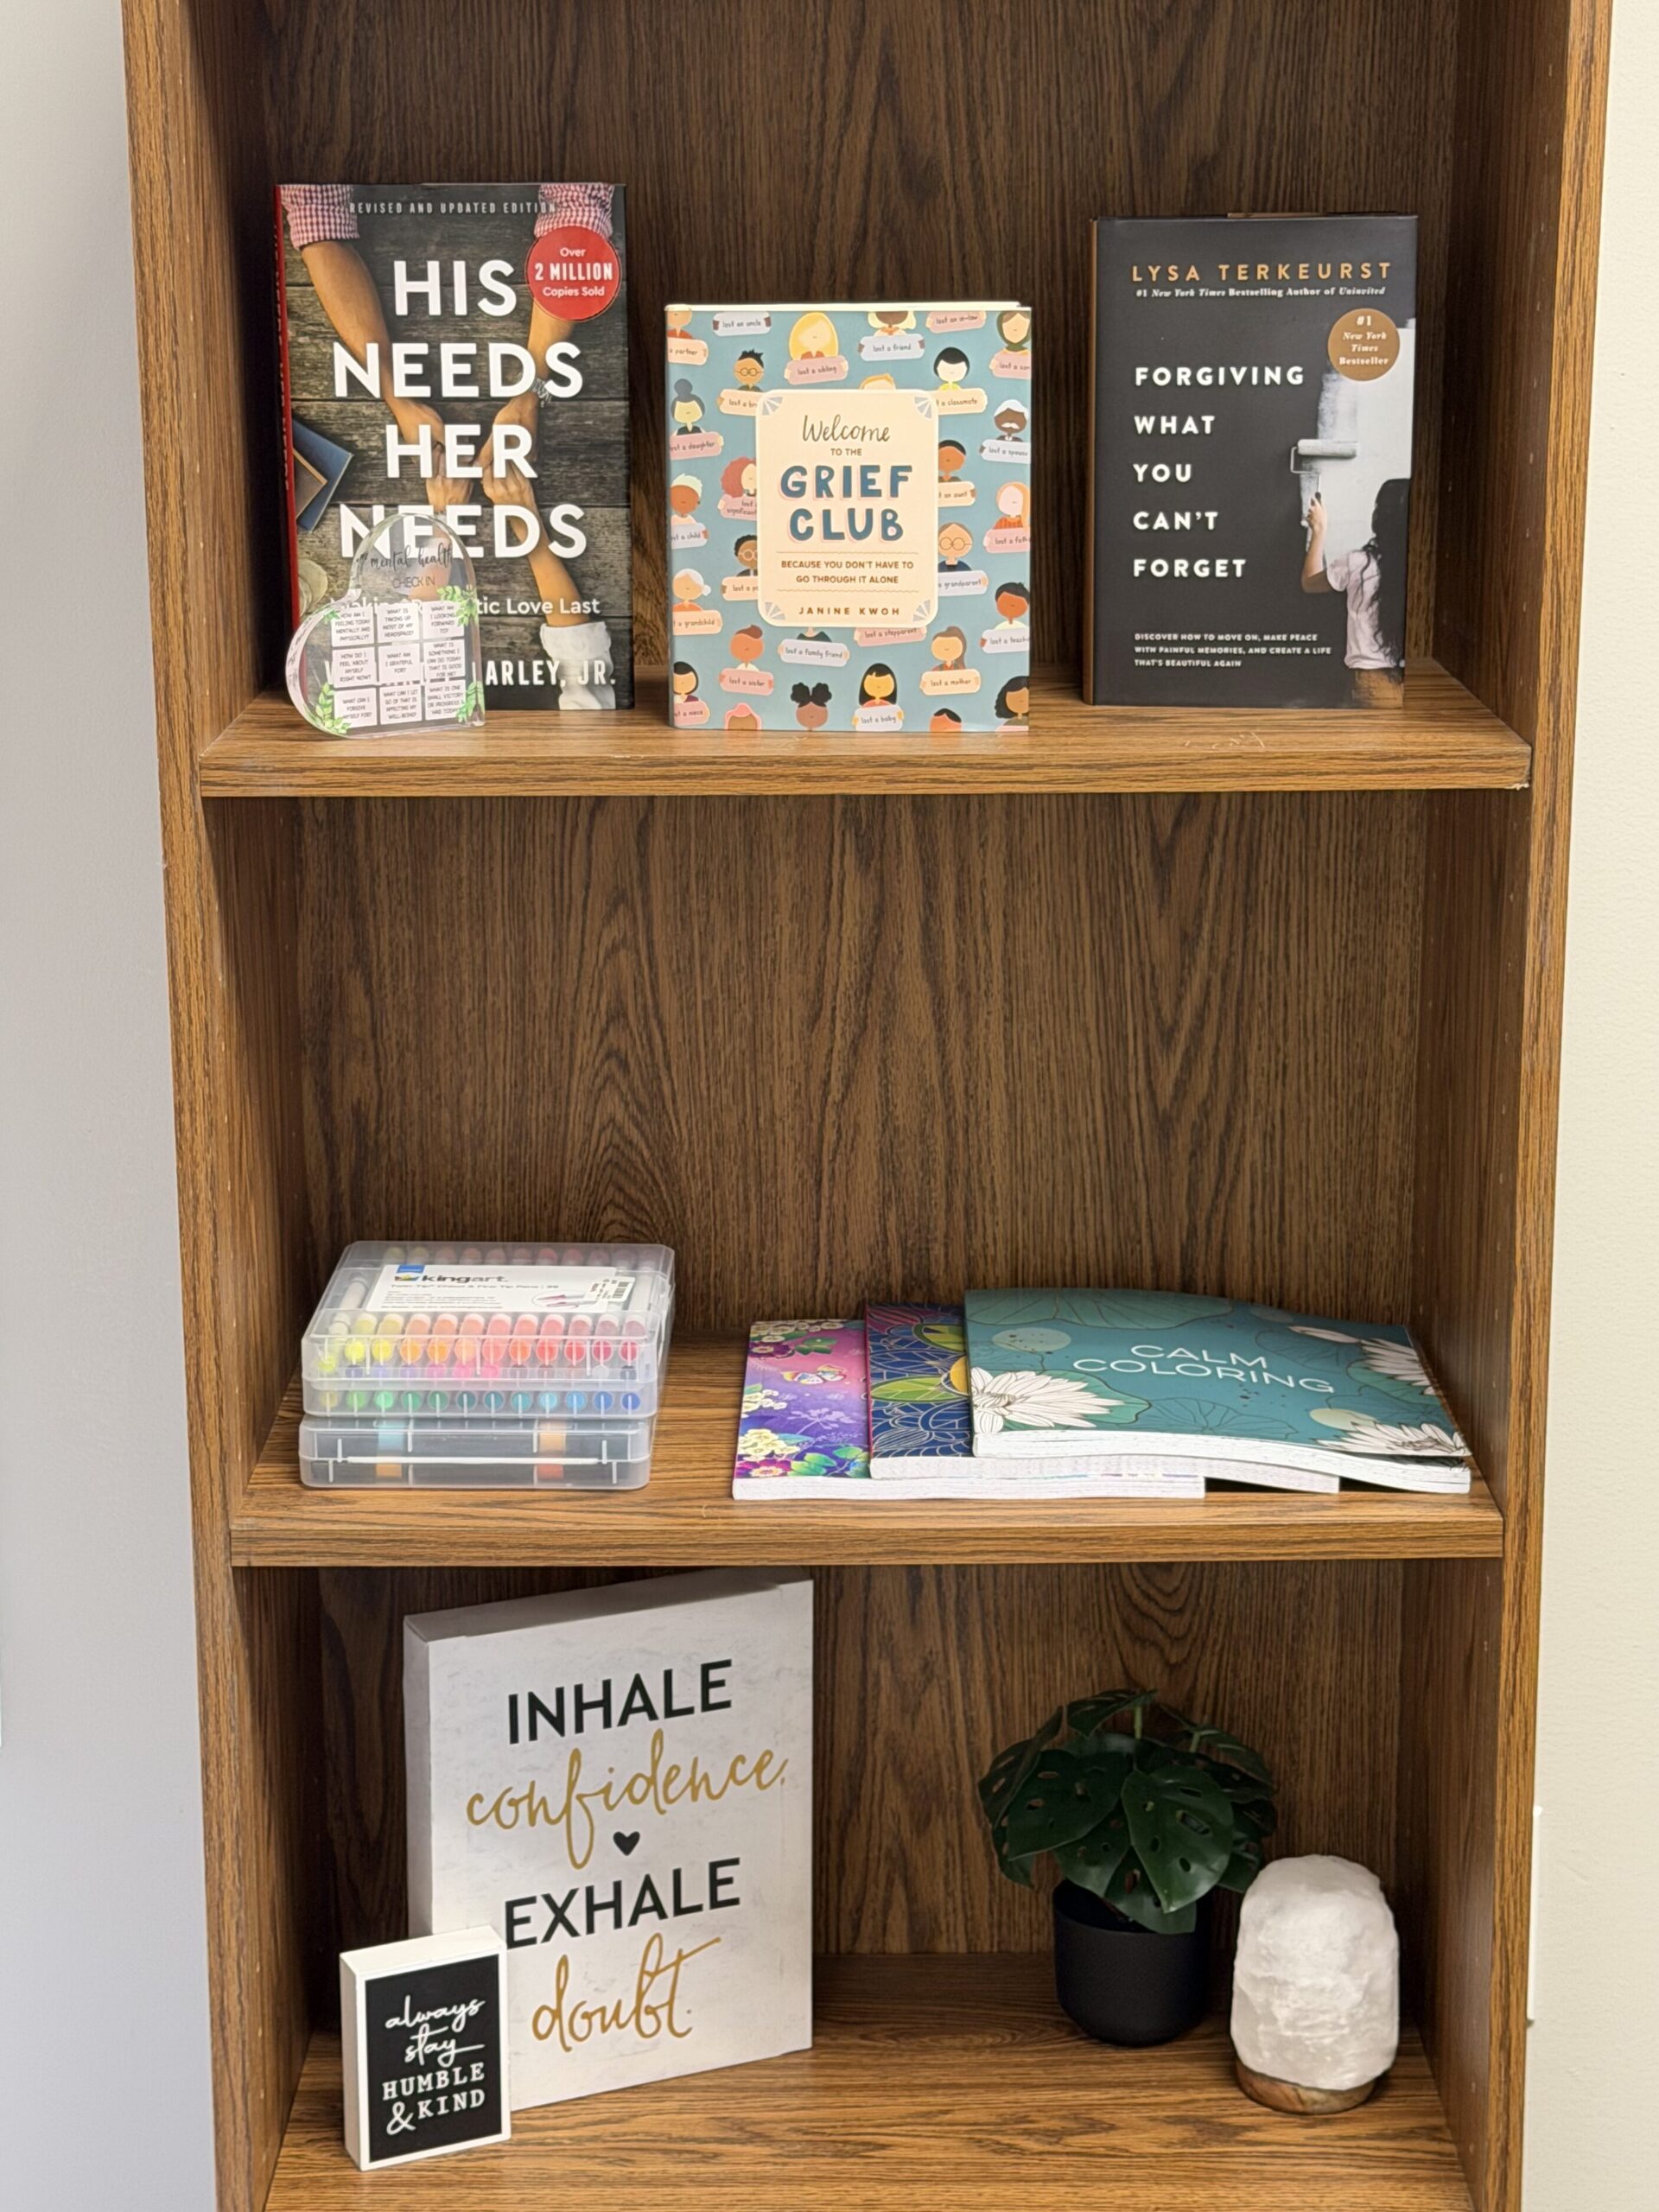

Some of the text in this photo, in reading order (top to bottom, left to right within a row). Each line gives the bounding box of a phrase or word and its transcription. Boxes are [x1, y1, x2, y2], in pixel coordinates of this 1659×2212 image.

[349, 201, 556, 213] REVISED AND UPDATED EDITION
[560, 247, 587, 257] Over
[535, 262, 613, 281] 2 MILLION
[1132, 262, 1390, 282] LYSA TERKEURST
[393, 259, 518, 316] HIS
[543, 286, 605, 297] Copies Sold
[1135, 286, 1385, 298] #1 New York Times Bestselling Author of Uninvited
[722, 320, 734, 328] lost
[746, 319, 761, 327] uncle
[1356, 315, 1372, 327] #1
[1343, 332, 1363, 340] New
[675, 347, 698, 356] partner
[1351, 344, 1379, 353] Times
[1338, 356, 1389, 365] Bestseller
[332, 341, 583, 398] NEEDS
[817, 365, 837, 374] sibling
[1135, 365, 1305, 387] FORGIVING
[728, 398, 741, 407] lost
[947, 398, 978, 407] classmate
[802, 414, 891, 443] Welcome
[1134, 416, 1215, 435] WHAT
[385, 423, 538, 479] HER
[689, 441, 715, 452] daughter
[830, 448, 862, 456] TO THE
[1133, 463, 1192, 483] YOU
[779, 464, 913, 499] GRIEF
[789, 507, 904, 542] CLUB
[1133, 511, 1218, 531] CAN'T
[339, 503, 588, 559] NEEDS
[687, 531, 701, 540] child
[781, 560, 822, 569] BECAUSE
[845, 561, 873, 569] DON'T
[875, 561, 899, 569] HAVE
[1133, 558, 1247, 579] FORGET
[813, 575, 856, 584] THROUGH
[944, 578, 982, 589] grandparent
[506, 597, 554, 615] Love
[561, 598, 601, 615] Last
[798, 607, 850, 615] JANINE
[684, 619, 715, 628] grandchild
[1135, 632, 1179, 642] DISCOVER
[1180, 633, 1201, 642] HOW
[1217, 633, 1243, 642] MOVE
[1244, 633, 1262, 643] ON,
[1263, 633, 1287, 642] MAKE
[1289, 633, 1318, 642] PEACE
[804, 648, 823, 659] family
[824, 650, 843, 658] friend
[1197, 646, 1246, 656] MEMORIES,
[1248, 646, 1268, 655] AND
[1269, 646, 1303, 655] CREATE
[1304, 646, 1311, 655] A
[1313, 646, 1332, 655] LIFE
[1165, 659, 1211, 668] BEAUTIFUL
[1213, 659, 1242, 668] AGAIN
[576, 659, 616, 686] JR.
[880, 715, 897, 725] baby
[422, 1274, 505, 1284] kingart
[1130, 1344, 1268, 1370] CALM
[1072, 1357, 1335, 1394] COLORING
[507, 1658, 733, 1745] INHALE
[505, 1856, 741, 1950] EXHALE
[384, 1994, 486, 2034] always
[404, 2022, 486, 2069] stay
[382, 2061, 486, 2101] HUMBLE
[385, 2088, 486, 2136] & KIND
